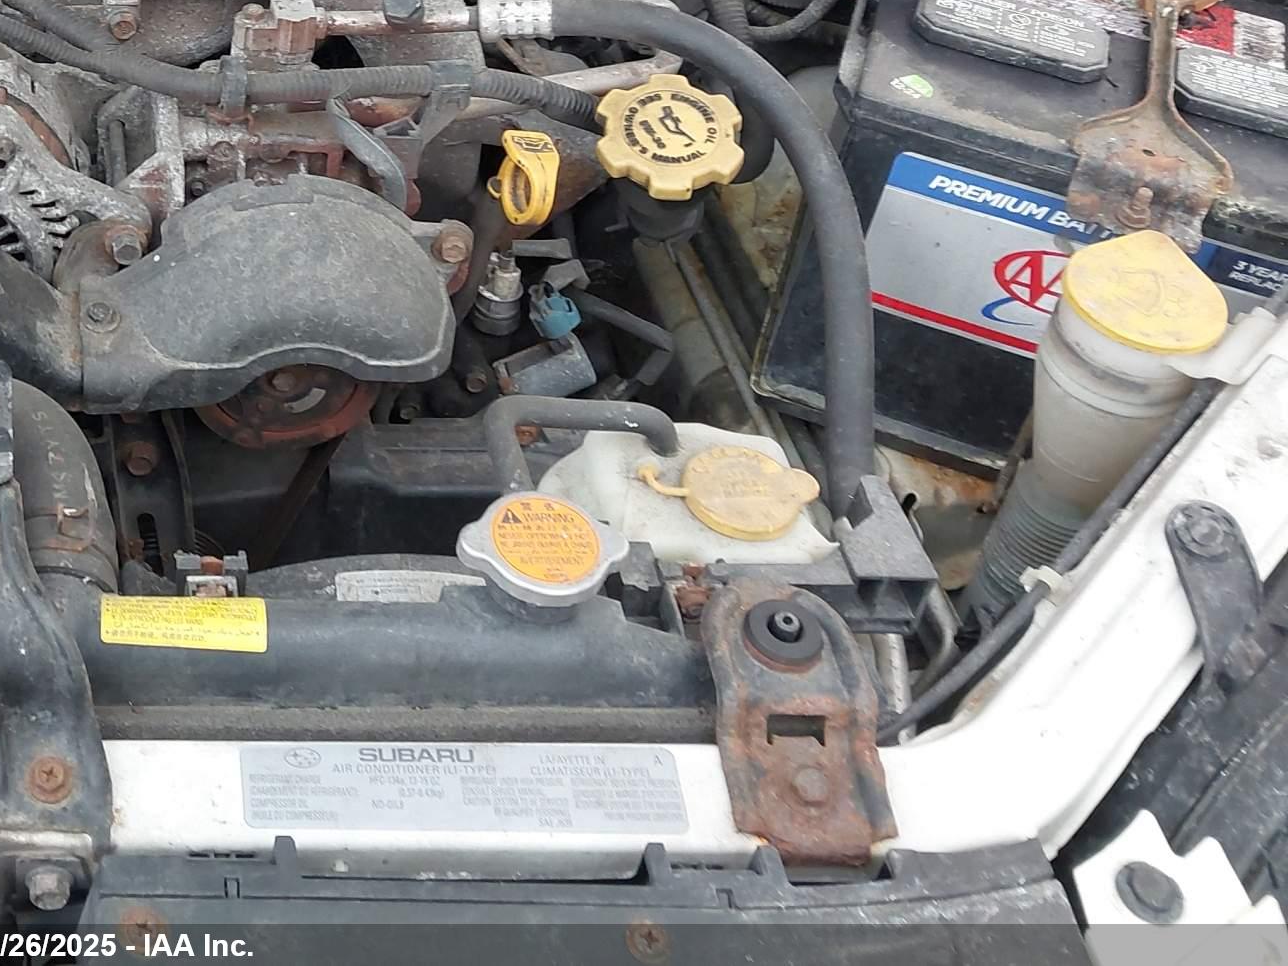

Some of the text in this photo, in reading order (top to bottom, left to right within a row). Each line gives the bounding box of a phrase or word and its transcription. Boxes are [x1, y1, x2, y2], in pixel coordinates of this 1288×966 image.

[1030, 8, 1085, 28] POISON
[704, 127, 718, 144] OIL
[651, 149, 707, 164] MANUAL
[928, 174, 1052, 222] PREMIUM
[1232, 260, 1249, 271] 3
[521, 512, 575, 524] WARNING
[359, 747, 475, 764] SUBARU
[653, 754, 665, 767] A
[331, 764, 354, 775] AIR
[355, 764, 441, 776] CONDITIONER
